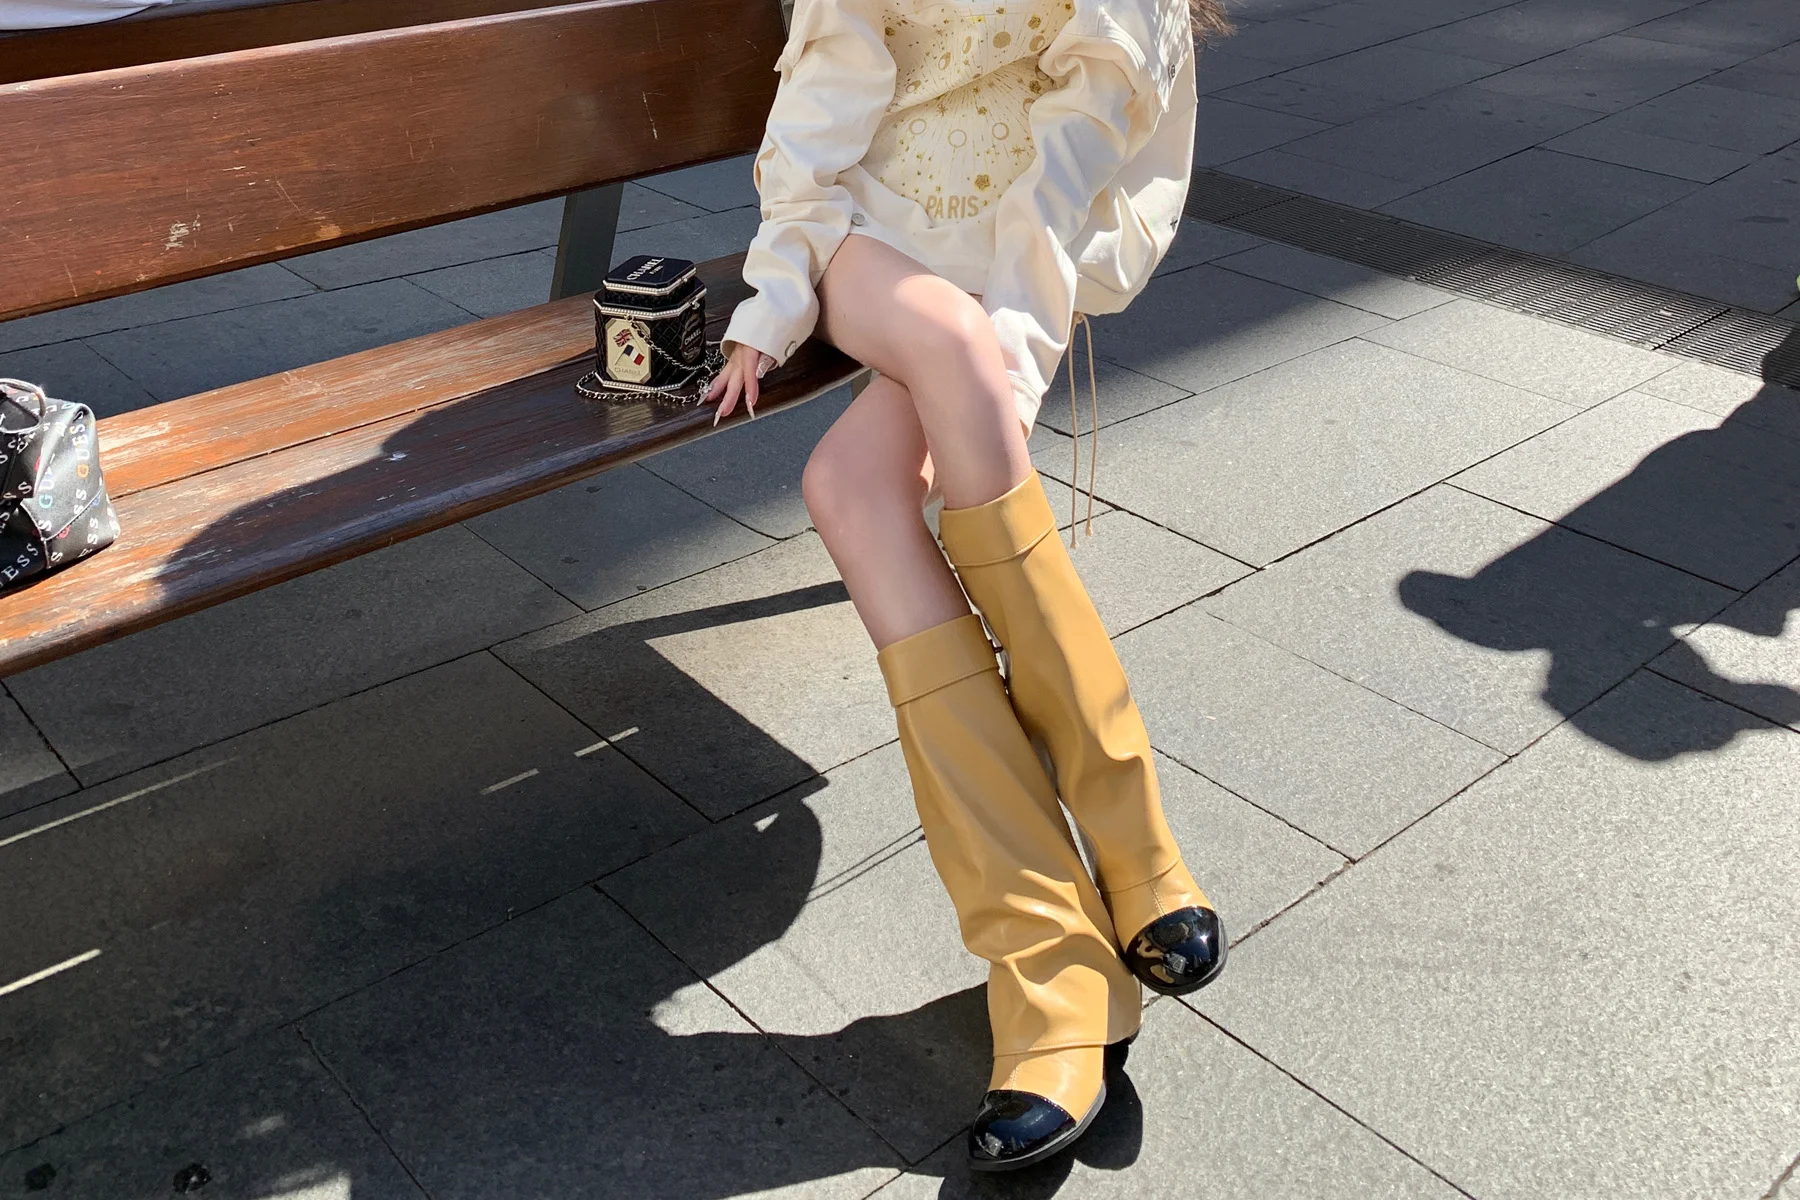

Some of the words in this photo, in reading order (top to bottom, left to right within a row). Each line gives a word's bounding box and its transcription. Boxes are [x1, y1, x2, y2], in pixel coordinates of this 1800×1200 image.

[925, 195, 979, 219] PARIS
[626, 257, 665, 280] CHANEL
[684, 328, 702, 346] CHANEL
[614, 367, 642, 376] CHANEL
